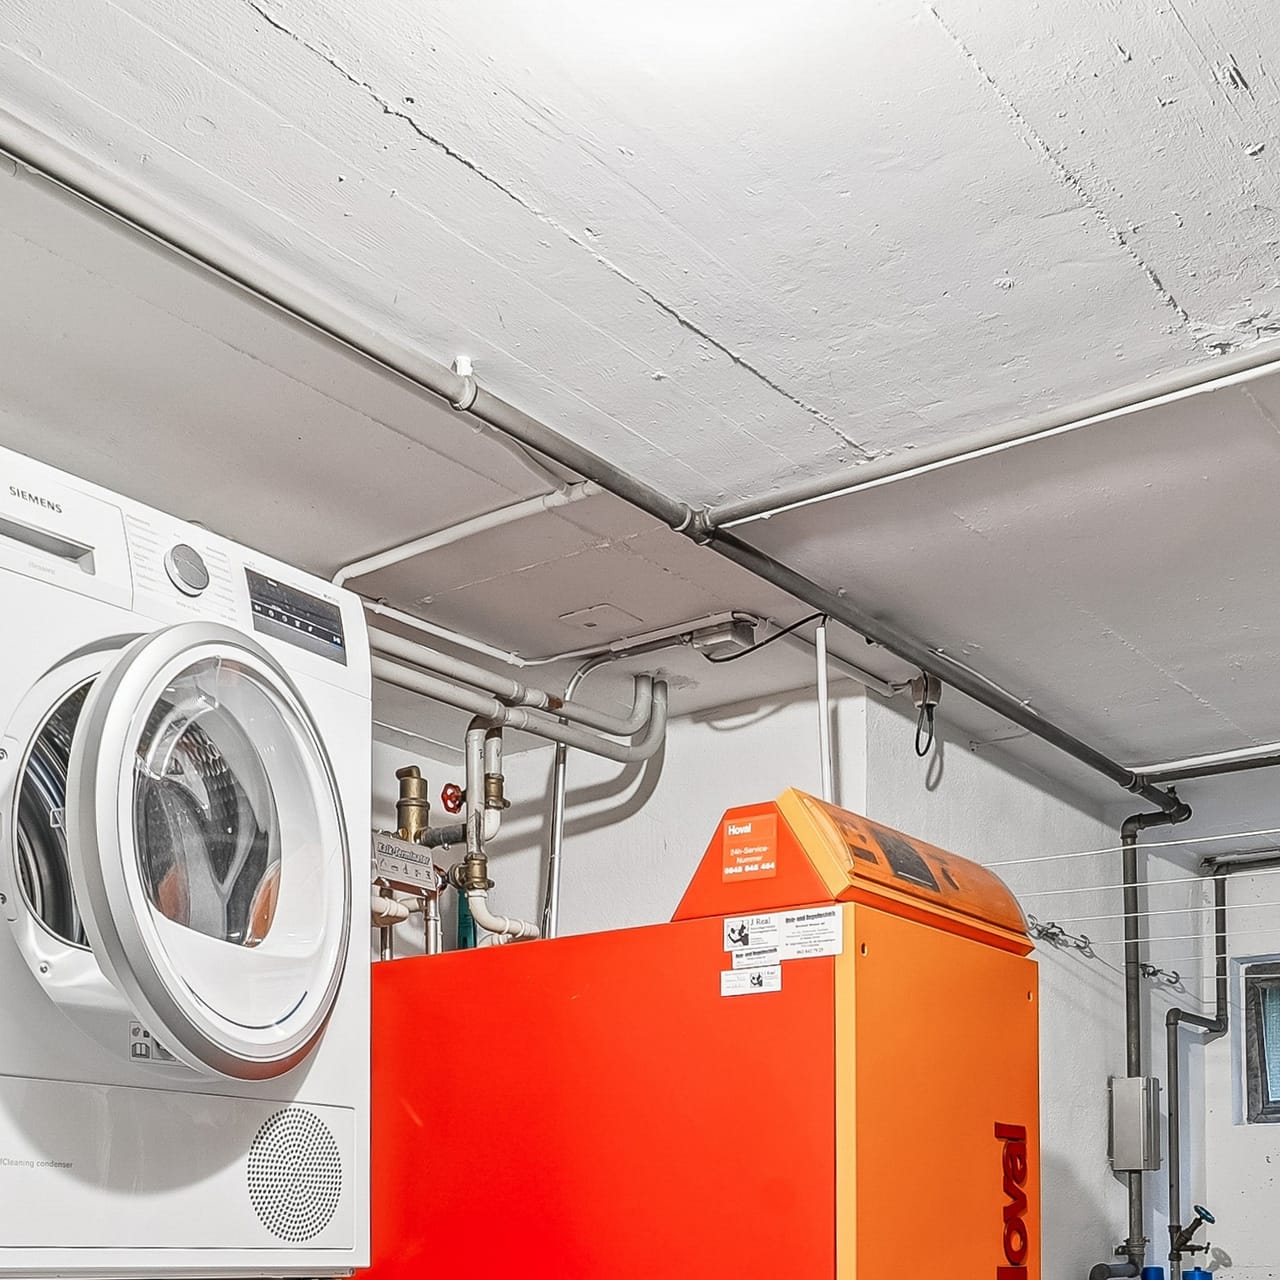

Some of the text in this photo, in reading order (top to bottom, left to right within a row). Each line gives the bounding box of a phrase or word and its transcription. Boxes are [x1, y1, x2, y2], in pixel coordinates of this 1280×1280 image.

[8, 485, 63, 514] SIEMENS
[727, 822, 752, 836] Hoval
[36, 1159, 73, 1169] condenser
